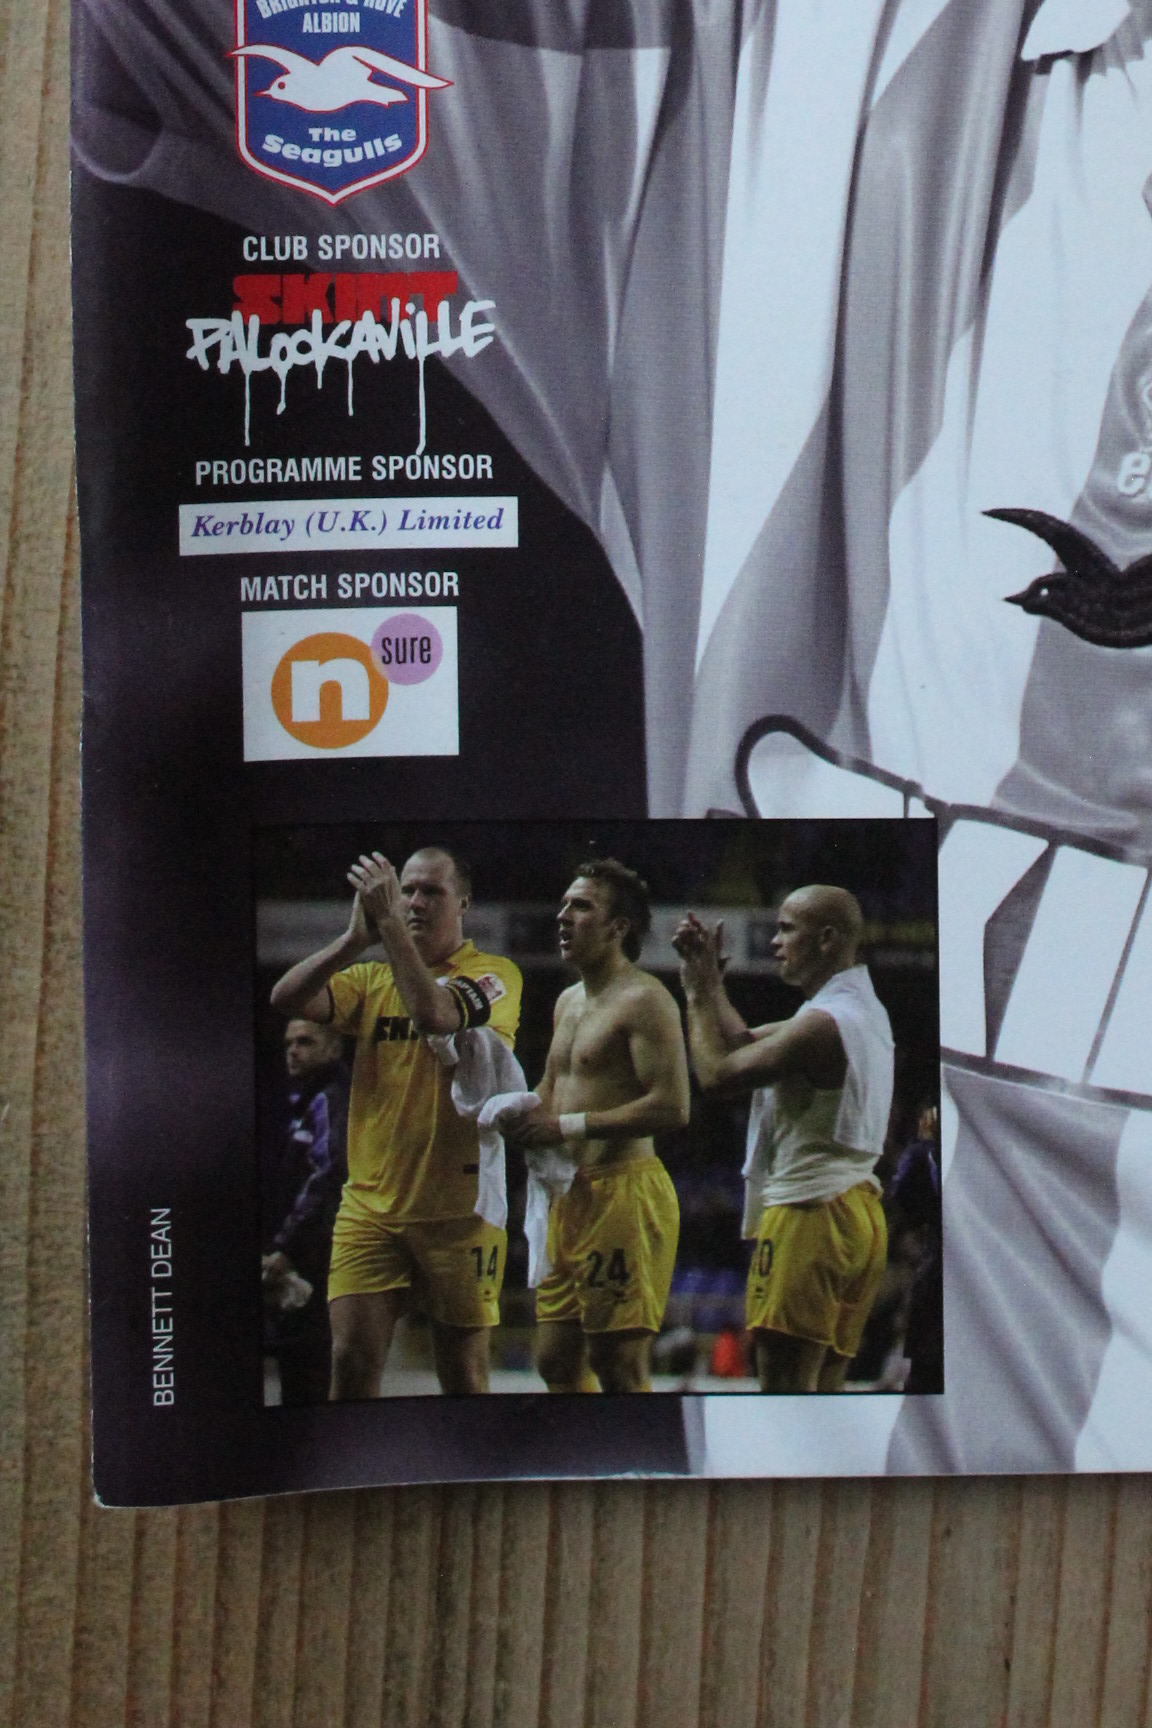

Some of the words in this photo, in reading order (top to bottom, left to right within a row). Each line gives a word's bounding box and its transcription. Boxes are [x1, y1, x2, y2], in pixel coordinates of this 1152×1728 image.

[302, 12, 360, 33] ALBION
[262, 133, 402, 167] Seagulls
[309, 127, 356, 142] The
[243, 235, 308, 261] CLUB
[318, 233, 441, 260] SPONSOR
[195, 456, 362, 485] PROGRAMME
[372, 454, 493, 480] SPONSOR
[190, 511, 295, 540] Kerblay
[306, 509, 388, 538] (U.K.)
[397, 508, 504, 532] Limited
[240, 574, 327, 601] MATCH
[338, 572, 459, 598] SPONSOR
[381, 636, 432, 665] sure
[150, 1208, 172, 1277] DEAN
[471, 1245, 498, 1280] 14
[586, 1248, 630, 1288] 24
[151, 1287, 174, 1406] BENNETT
